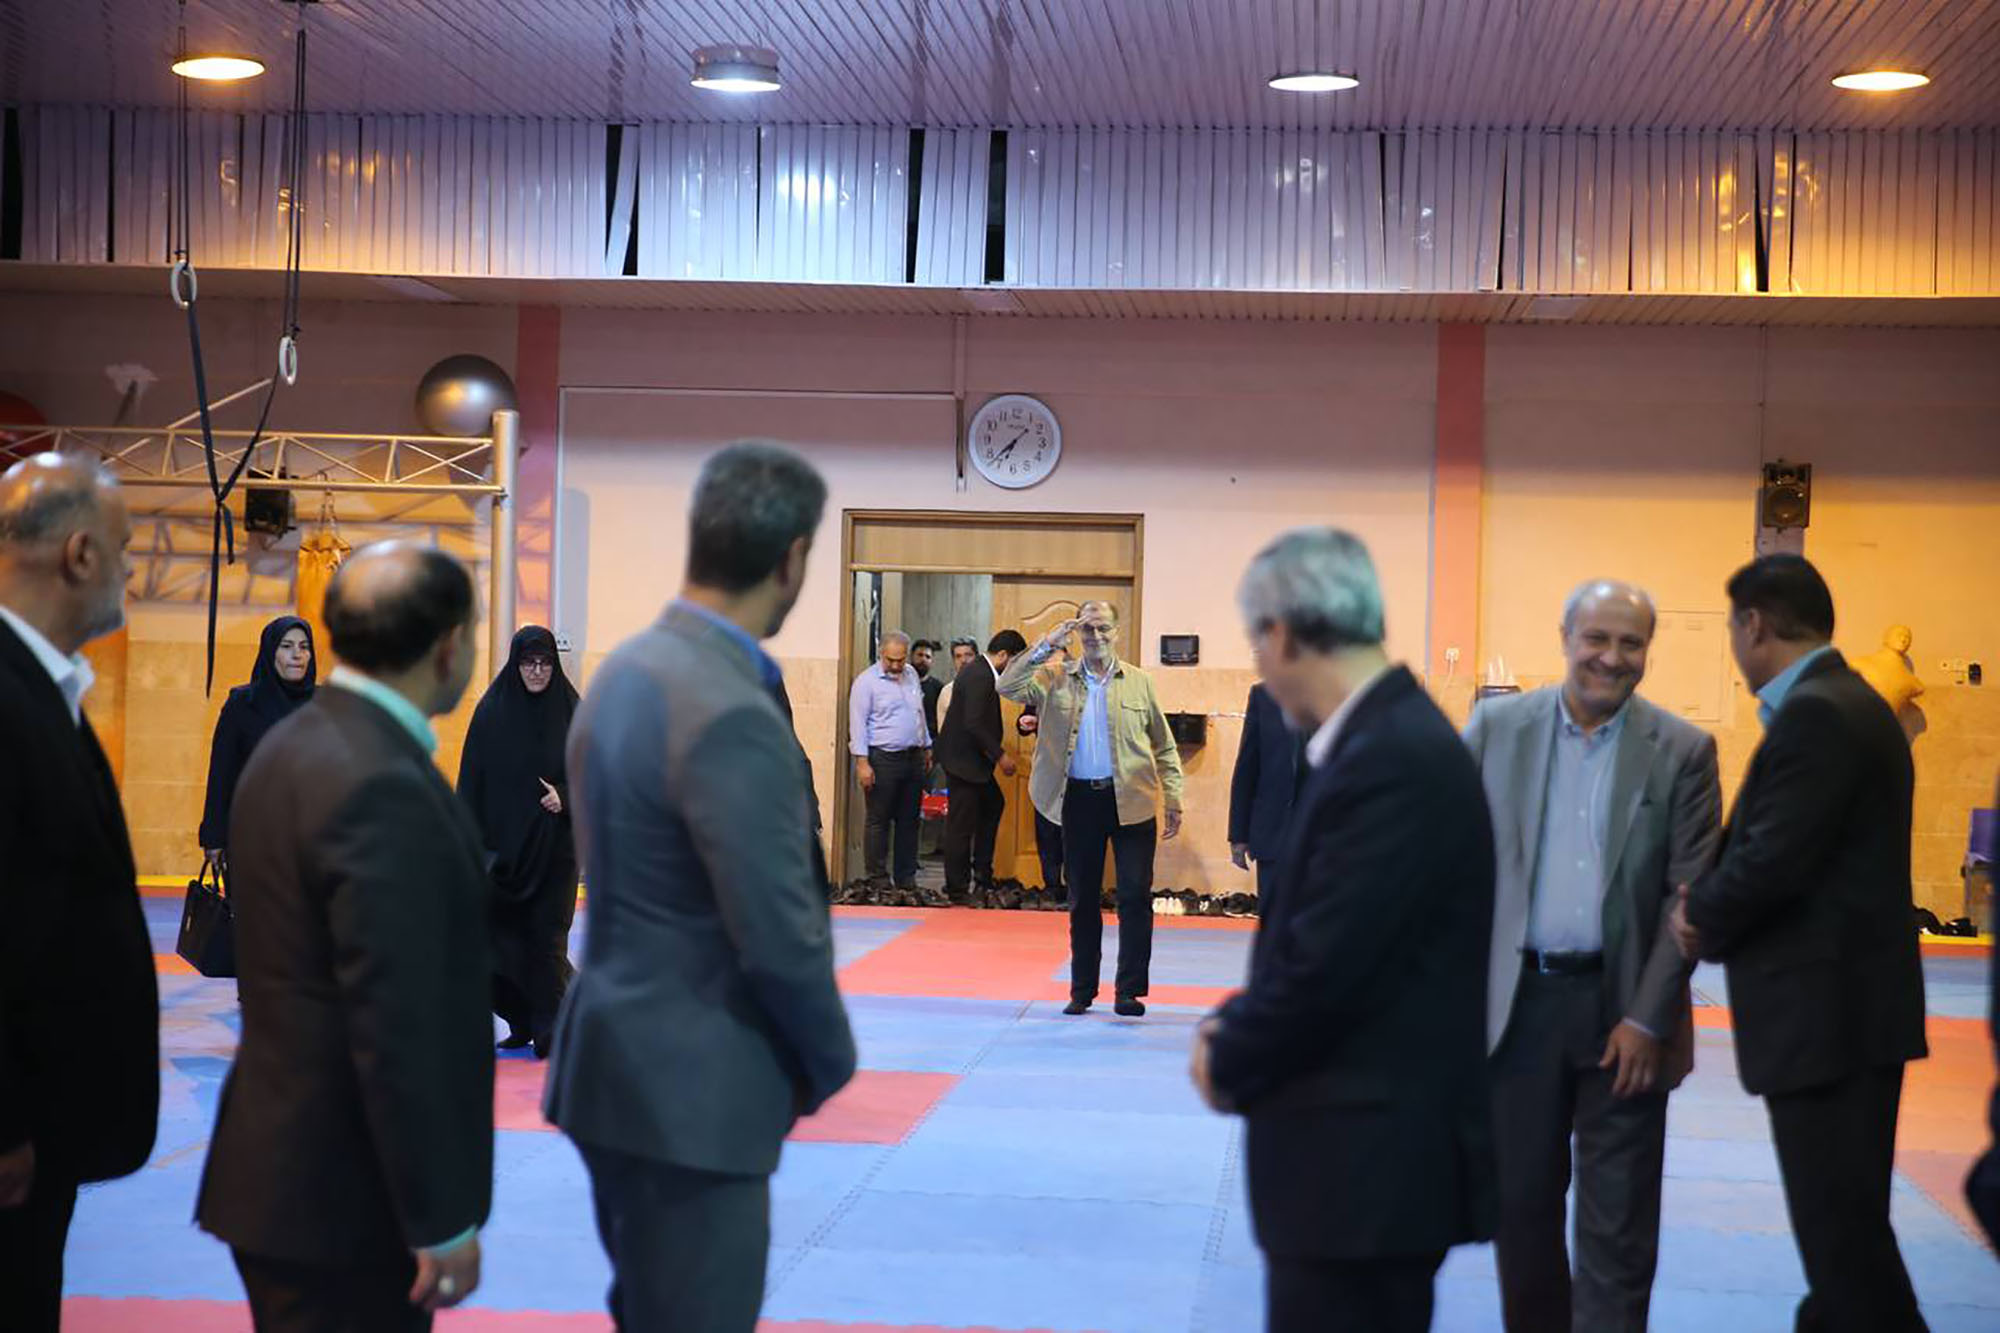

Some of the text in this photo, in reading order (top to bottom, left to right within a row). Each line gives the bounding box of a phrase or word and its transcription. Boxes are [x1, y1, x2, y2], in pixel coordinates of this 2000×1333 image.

[1000, 410, 1007, 421] 11
[1012, 408, 1023, 419] 12
[987, 420, 997, 431] 10
[1036, 423, 1043, 435] 2
[984, 435, 991, 445] 9
[1038, 437, 1047, 449] 3
[986, 448, 994, 459] 8
[1034, 451, 1041, 461] 4
[996, 458, 1004, 469] 7
[1023, 460, 1031, 471] 5
[1010, 464, 1016, 475] 6
